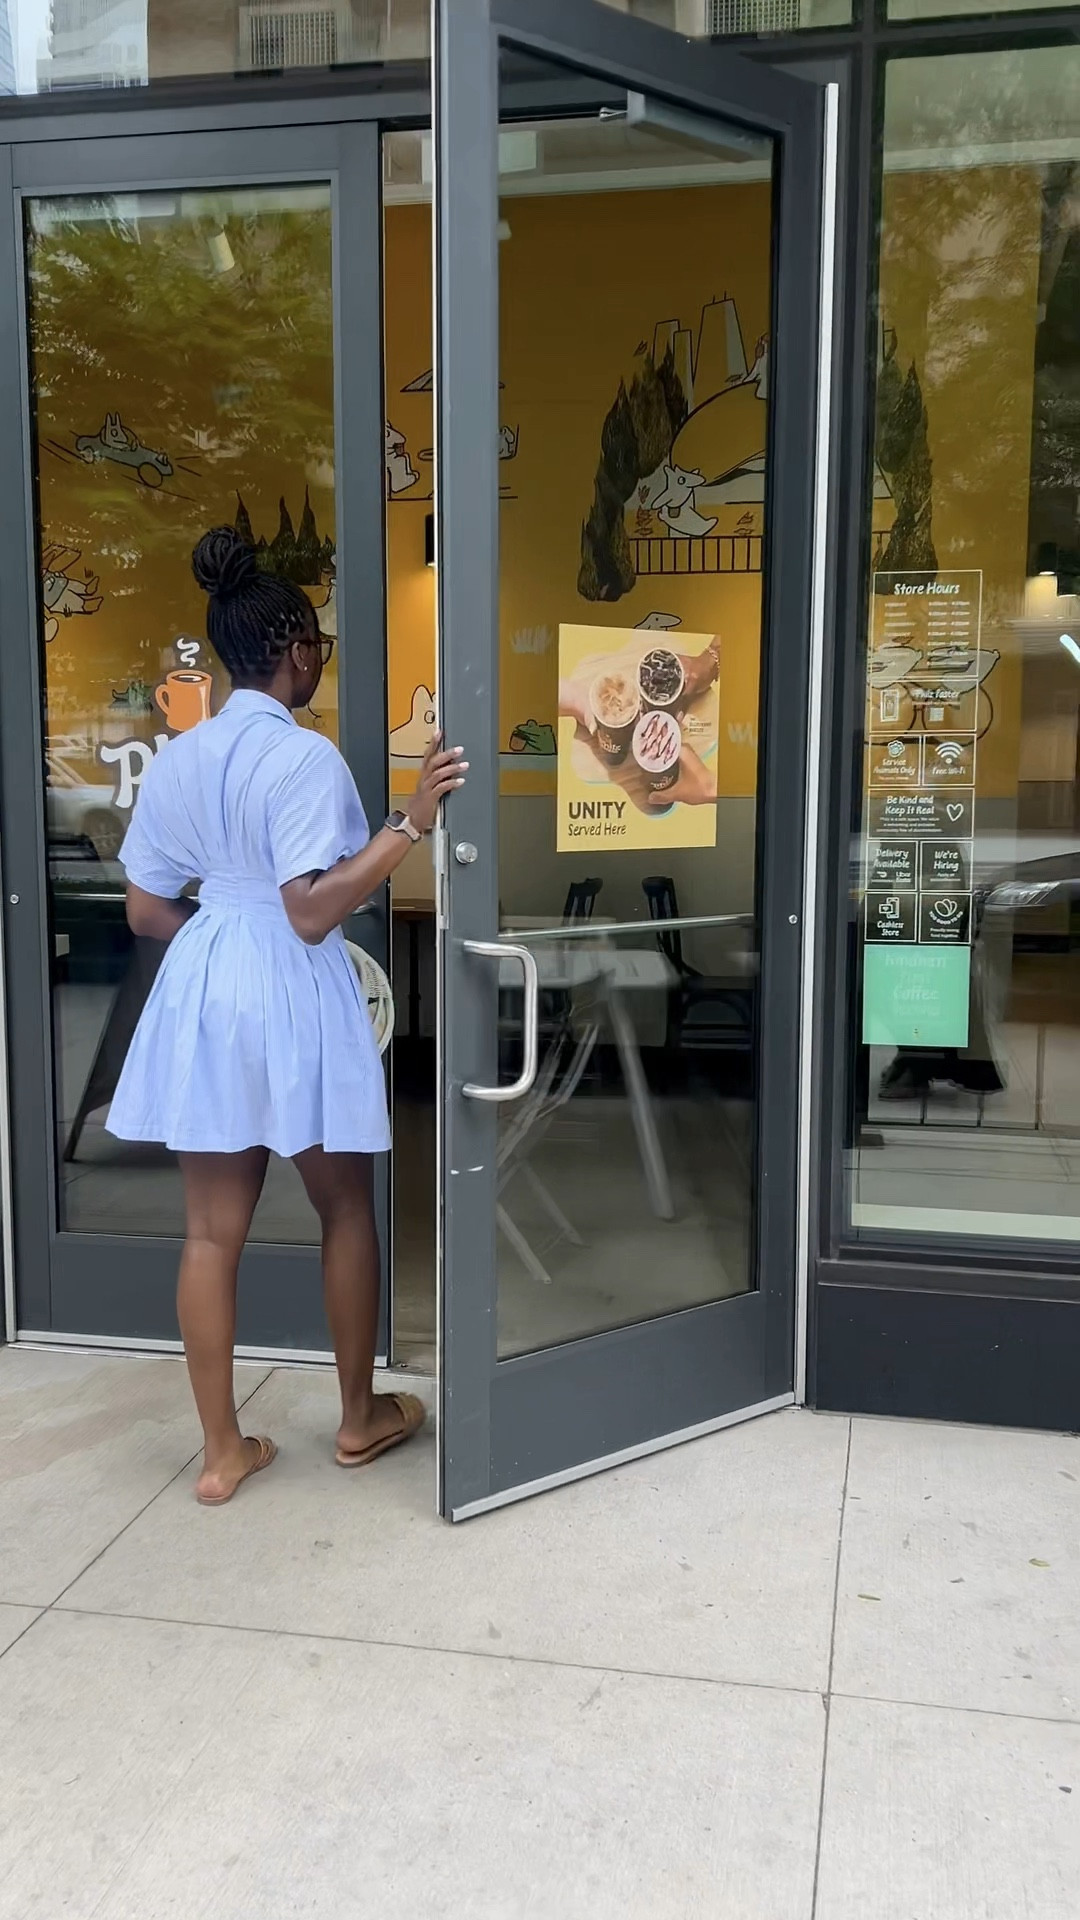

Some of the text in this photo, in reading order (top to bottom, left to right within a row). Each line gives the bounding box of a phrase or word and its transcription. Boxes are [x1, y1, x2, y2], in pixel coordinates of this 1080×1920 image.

[894, 582, 960, 595] Store Hours
[900, 766, 916, 776] Only
[932, 767, 947, 775] Free
[886, 795, 934, 804] Be Kind and
[568, 801, 627, 819] UNITY
[885, 805, 935, 817] Keep It Real
[568, 822, 627, 837] Served Here
[875, 848, 909, 859] Delivery
[934, 850, 958, 859] We're
[873, 860, 910, 869] Available
[933, 861, 959, 872] Hiring
[877, 920, 905, 929] Cashless
